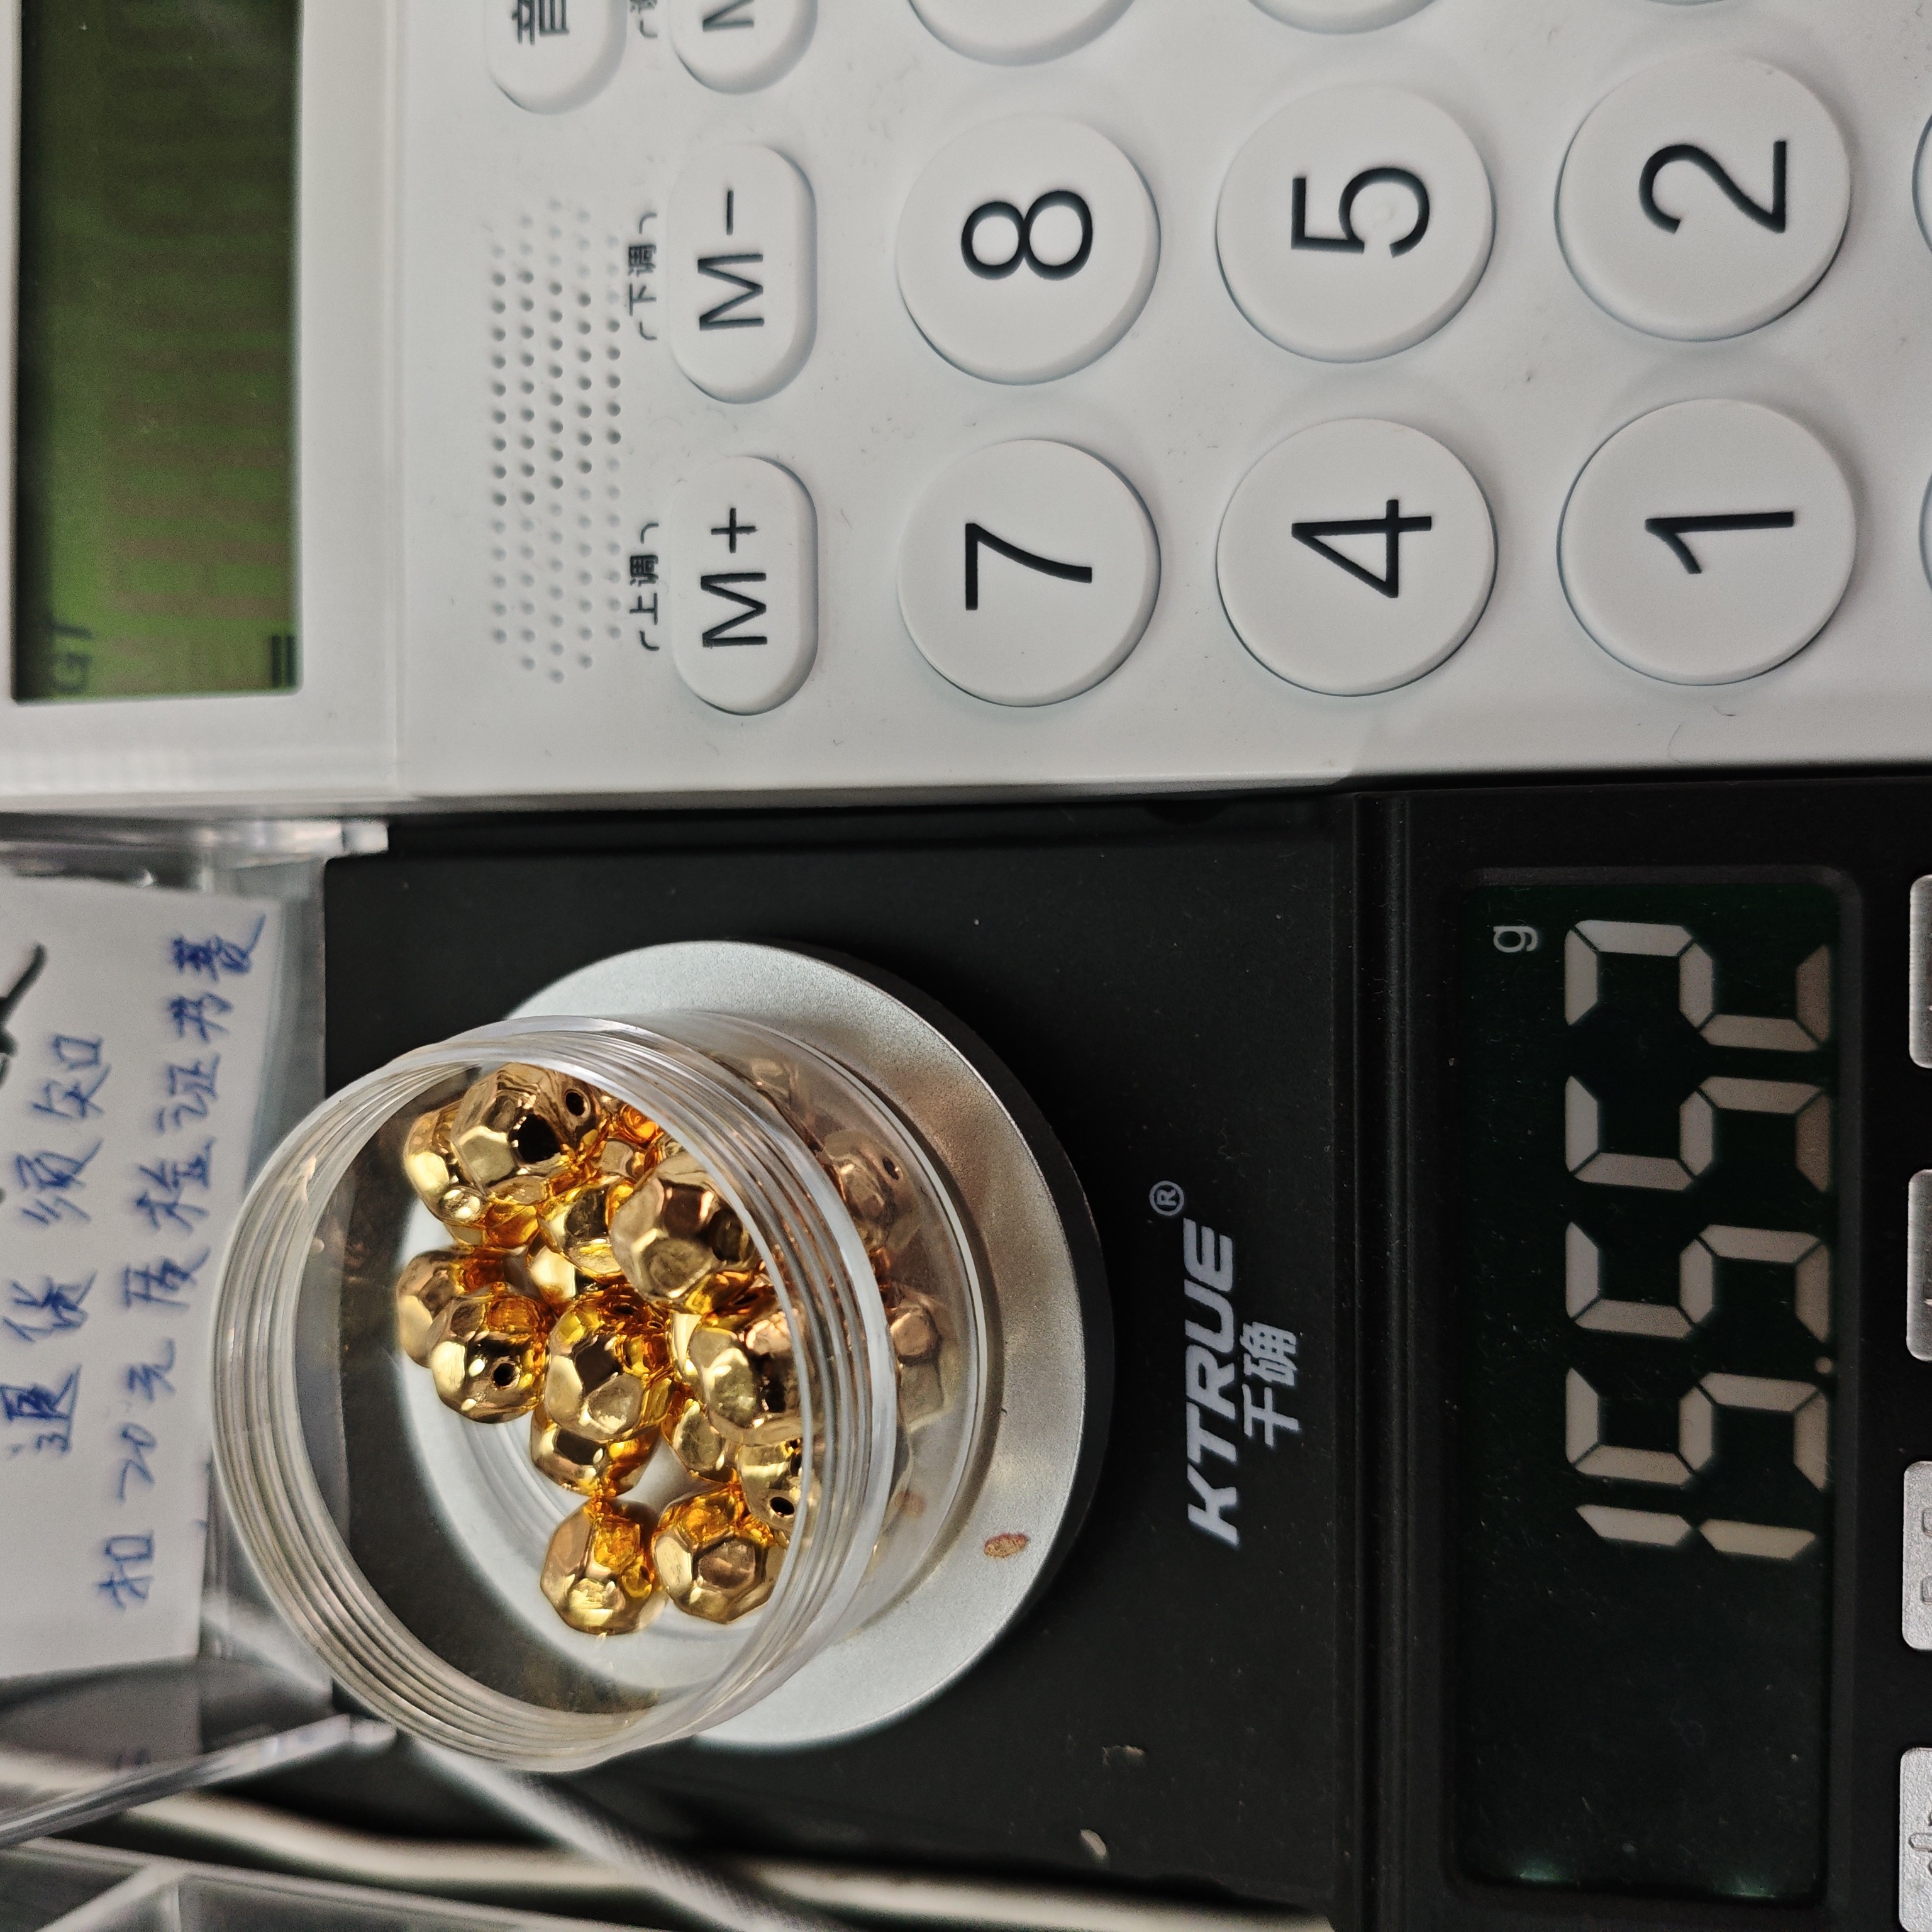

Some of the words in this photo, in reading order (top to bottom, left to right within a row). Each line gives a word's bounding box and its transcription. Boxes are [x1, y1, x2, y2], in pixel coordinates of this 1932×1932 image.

[1291, 166, 1431, 257] 5
[1639, 140, 1788, 234] 2
[960, 189, 1094, 280] 8
[700, 507, 768, 649] M+
[965, 522, 1093, 611] 7
[1291, 499, 1433, 599] 4
[1645, 510, 1796, 575] 1
[1493, 924, 1538, 953] g
[1564, 919, 1833, 1561] 15.552
[1183, 1218, 1240, 1546] KTRUE
[1239, 1321, 1302, 1448] 千确
